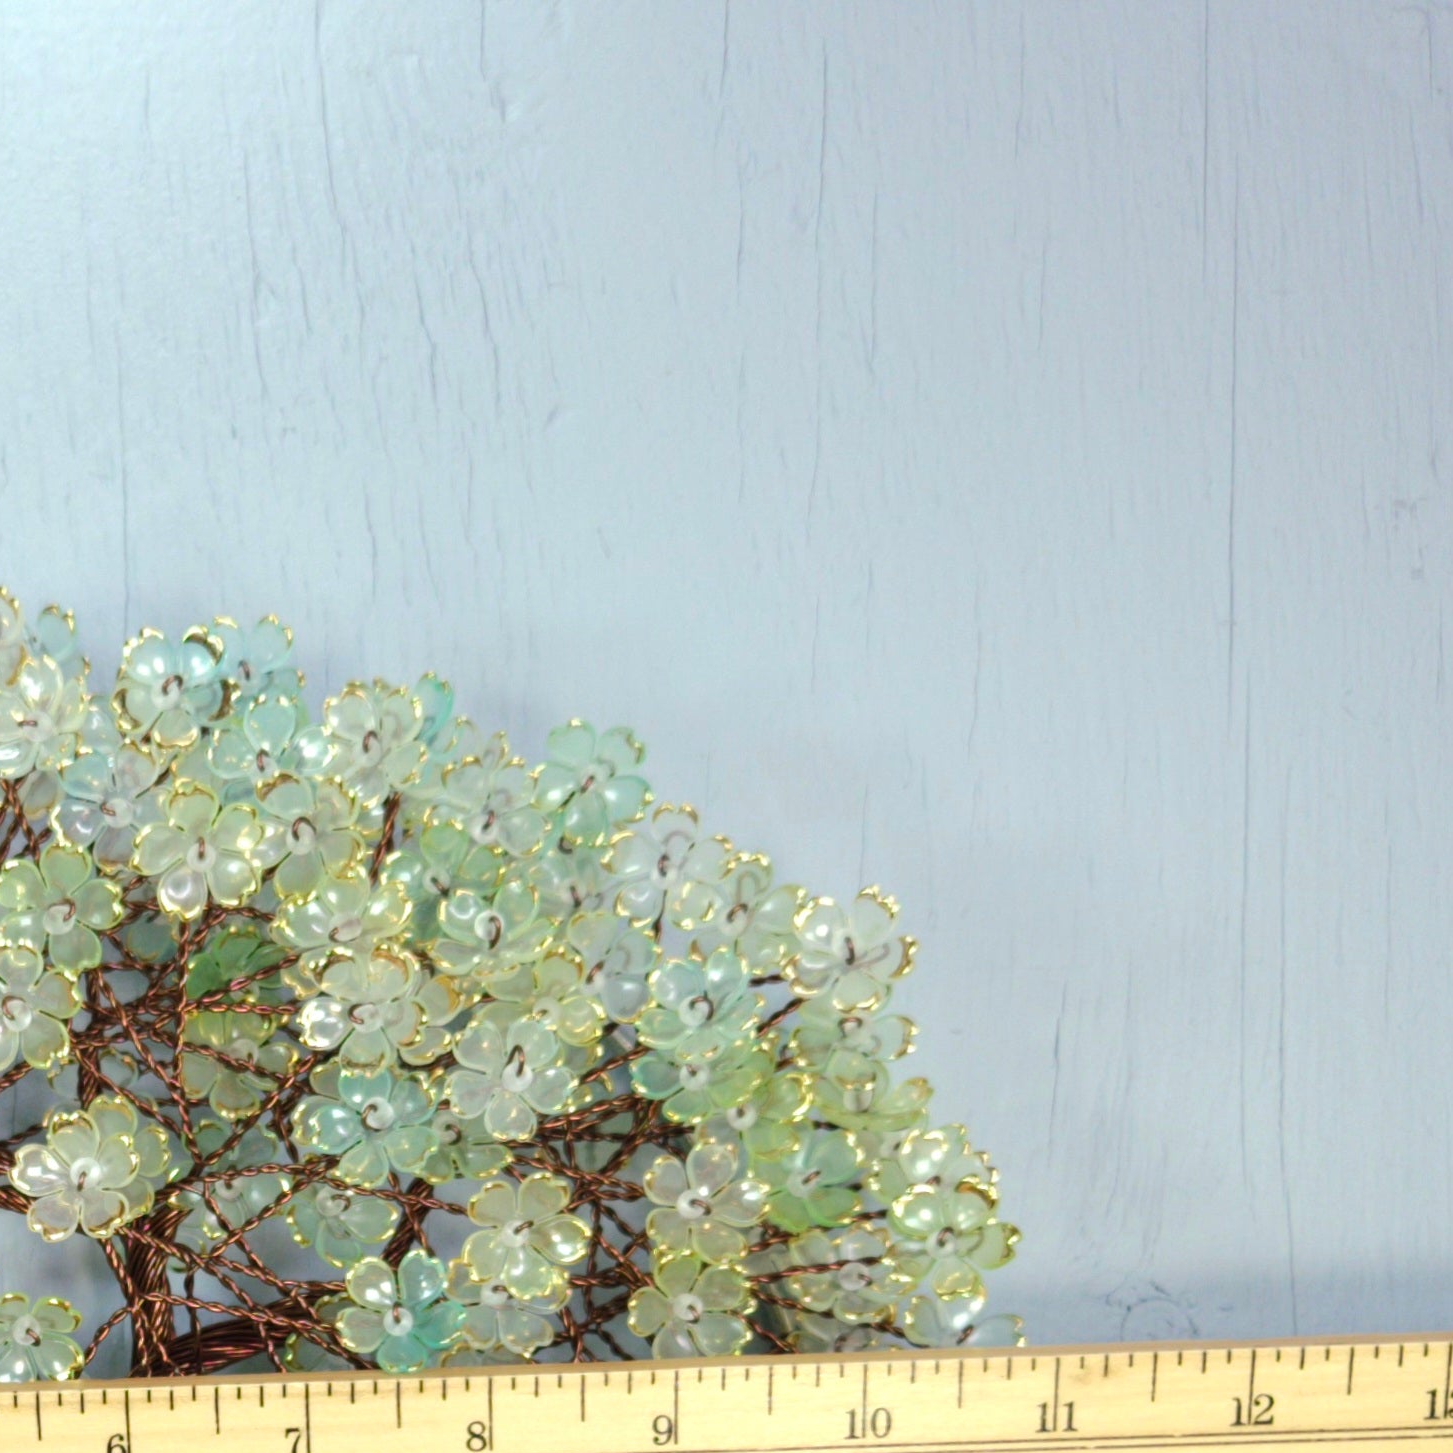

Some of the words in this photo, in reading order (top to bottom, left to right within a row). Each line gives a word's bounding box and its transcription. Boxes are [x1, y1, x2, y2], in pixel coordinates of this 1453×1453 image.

[844, 1408, 892, 1440] 10
[1035, 1401, 1079, 1434] 11
[1230, 1393, 1275, 1427] 12
[466, 1420, 487, 1452] 8
[652, 1414, 673, 1446] 9
